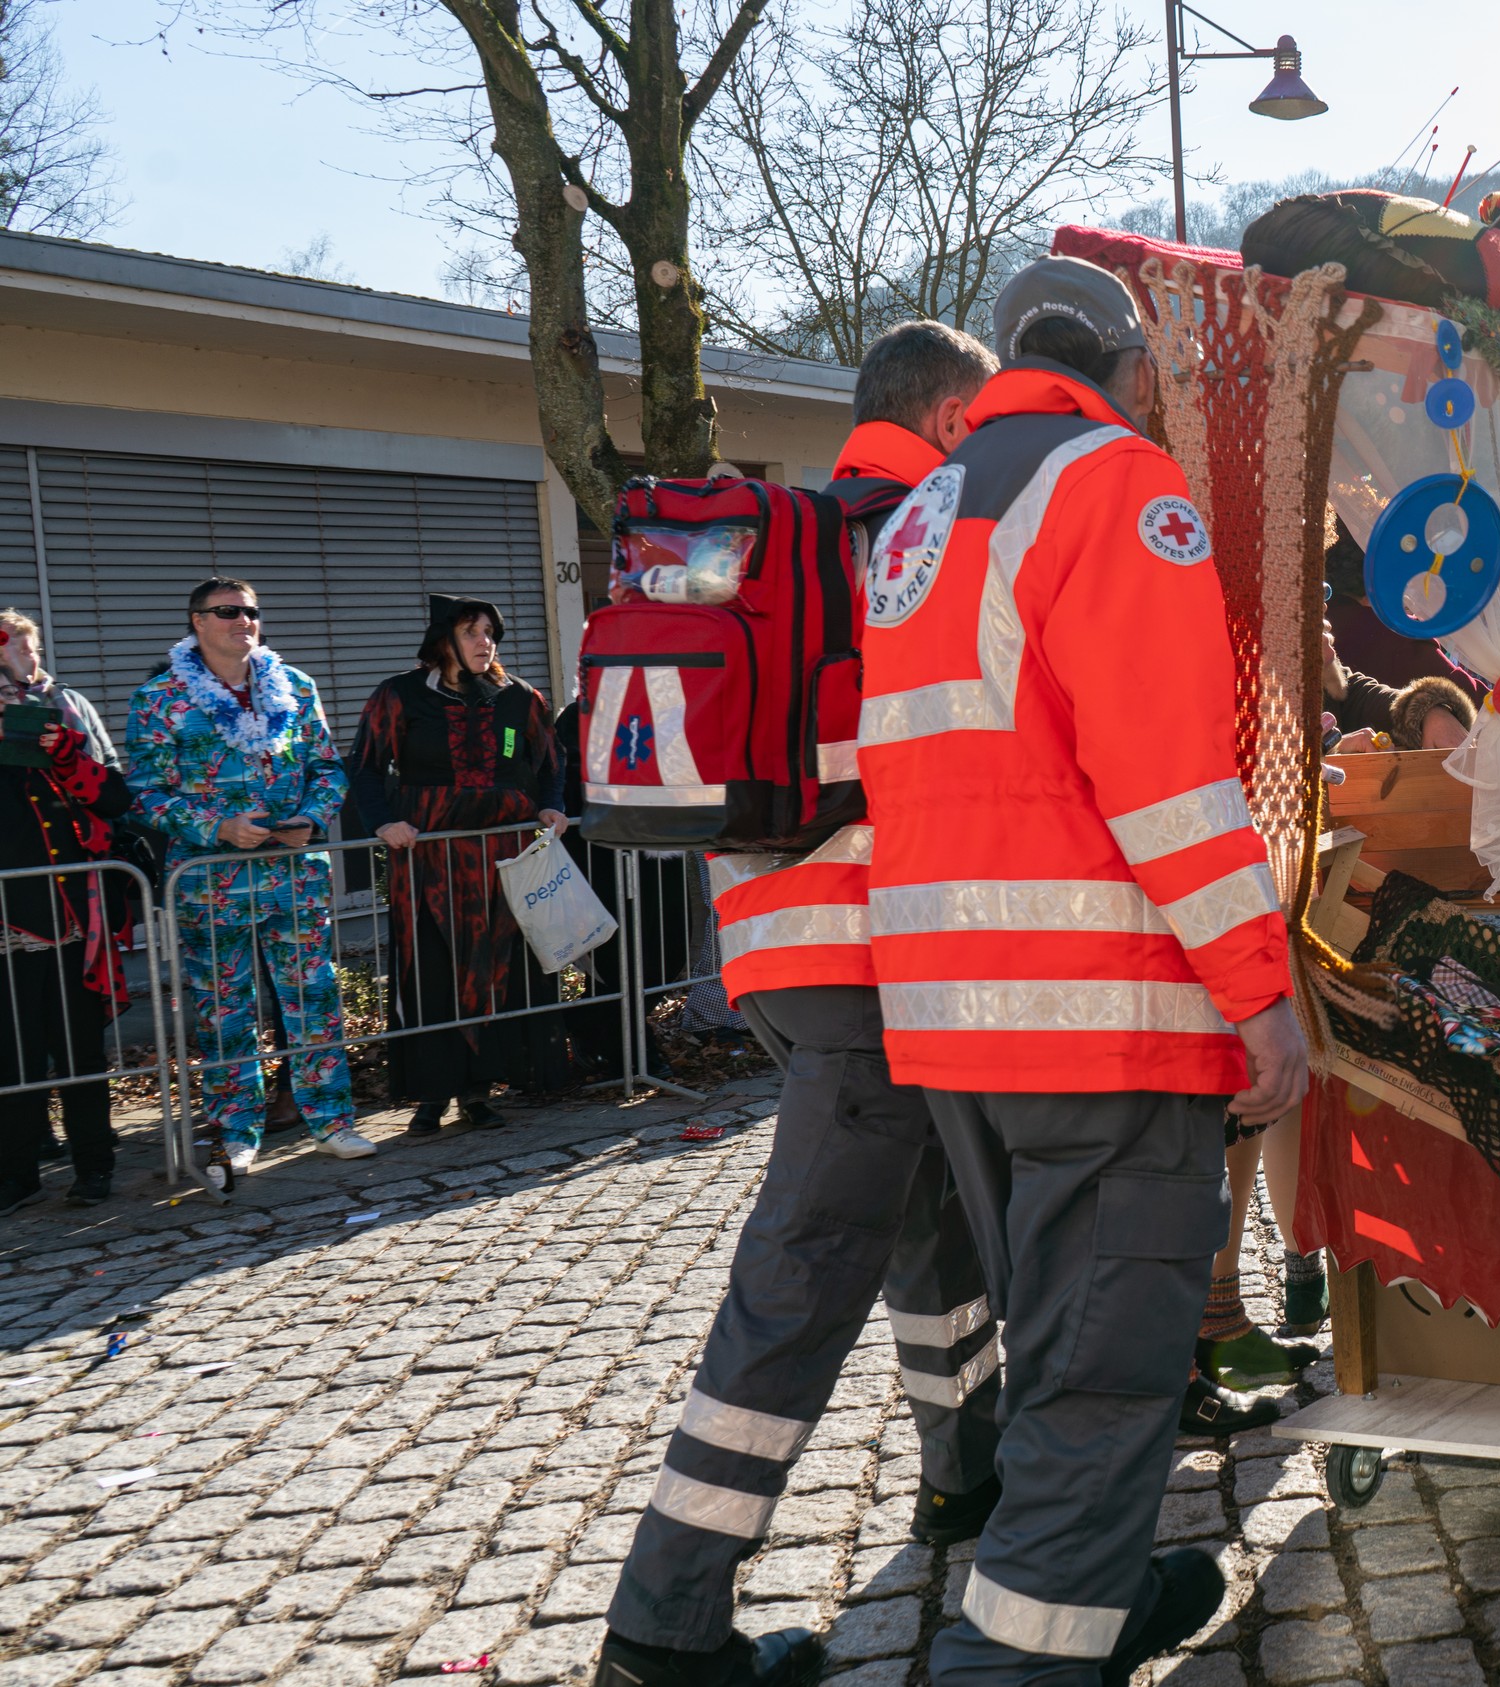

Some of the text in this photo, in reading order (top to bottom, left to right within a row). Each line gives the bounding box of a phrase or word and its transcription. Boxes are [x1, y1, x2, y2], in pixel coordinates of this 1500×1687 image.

[1042, 302, 1076, 316] Rotes
[1145, 501, 1198, 527] DEUTSCHES
[1149, 530, 1207, 559] ROTES KREUZ
[557, 562, 580, 583] 30
[896, 532, 943, 612] KREUZ
[524, 866, 572, 910] pepco
[1354, 1056, 1366, 1068] de
[1368, 1063, 1399, 1085] Nature
